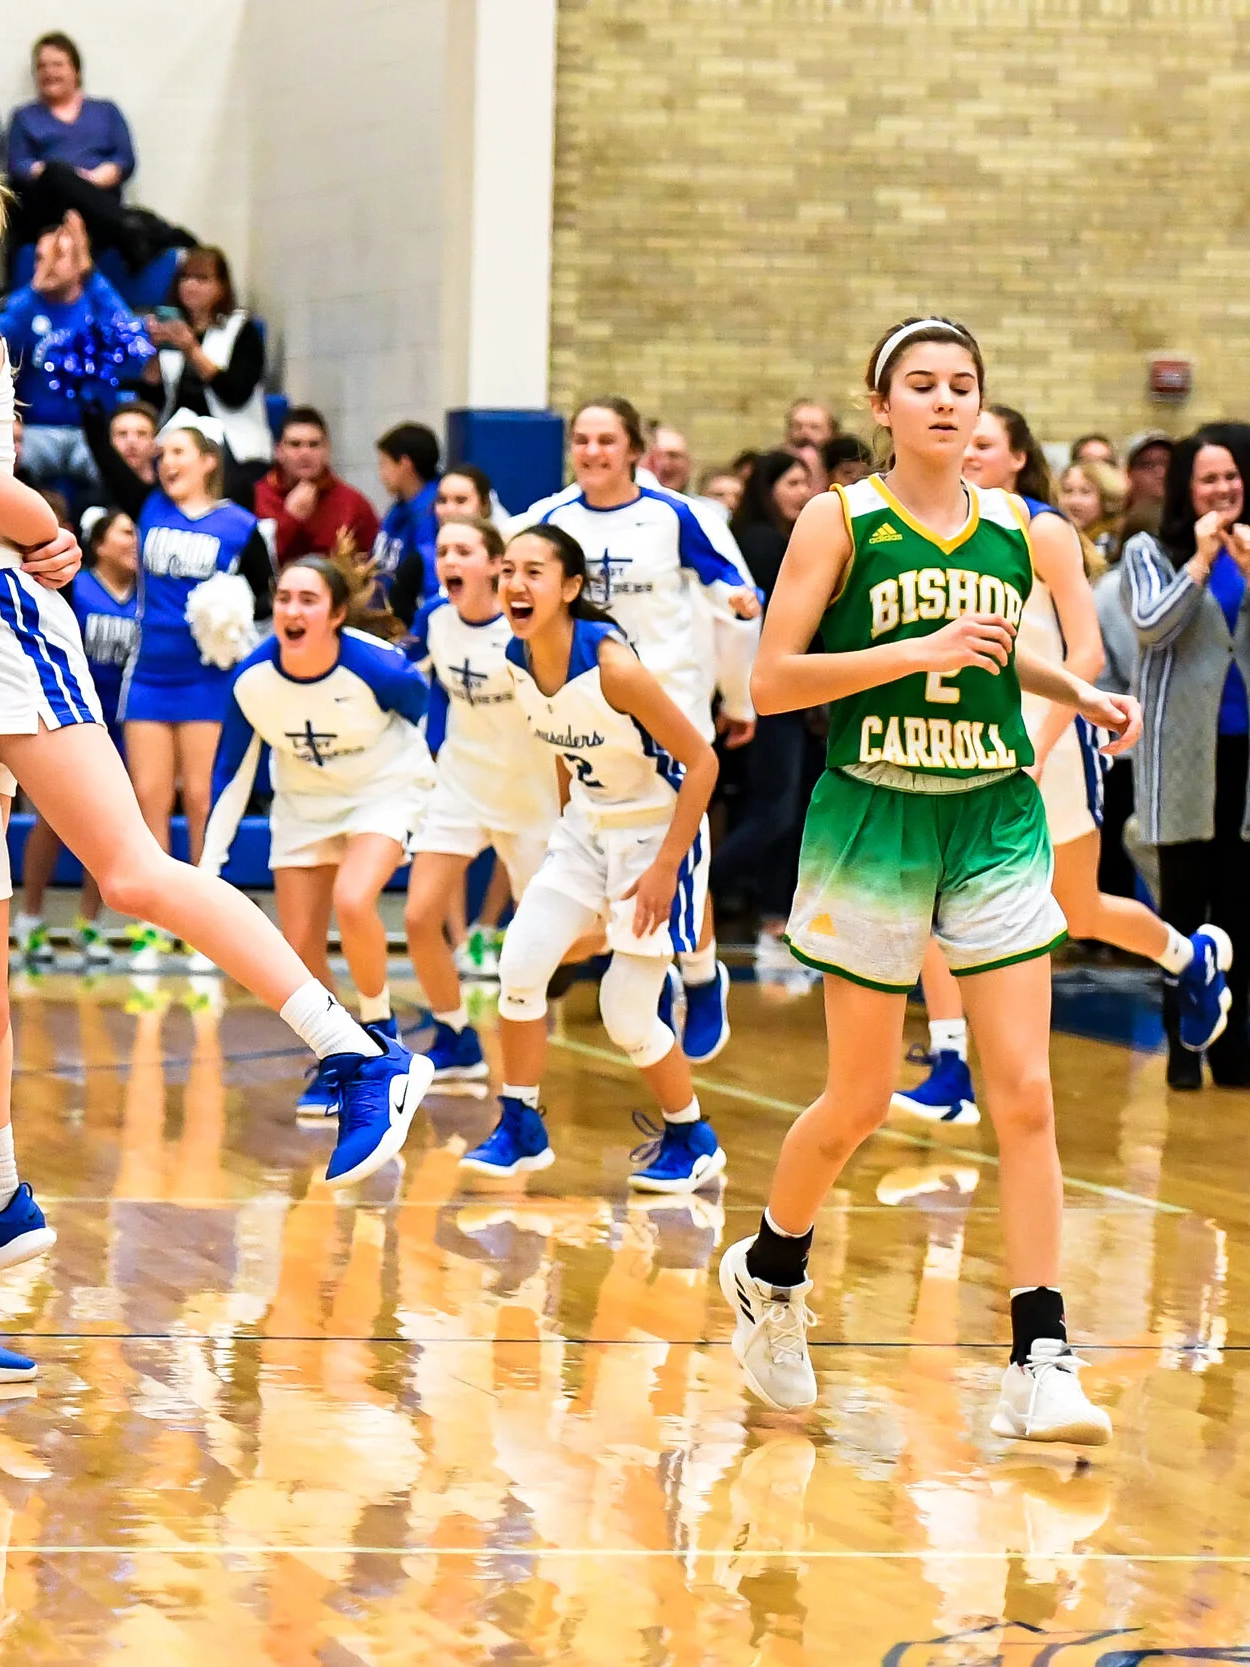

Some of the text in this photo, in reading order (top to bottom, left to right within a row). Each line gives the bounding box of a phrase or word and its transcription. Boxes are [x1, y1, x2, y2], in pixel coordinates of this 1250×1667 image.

[869, 534, 903, 544] adidas
[869, 568, 1023, 640] BISHOP
[529, 720, 605, 749] rusaders
[859, 715, 1017, 770] CARROLL
[563, 753, 607, 788] 2
